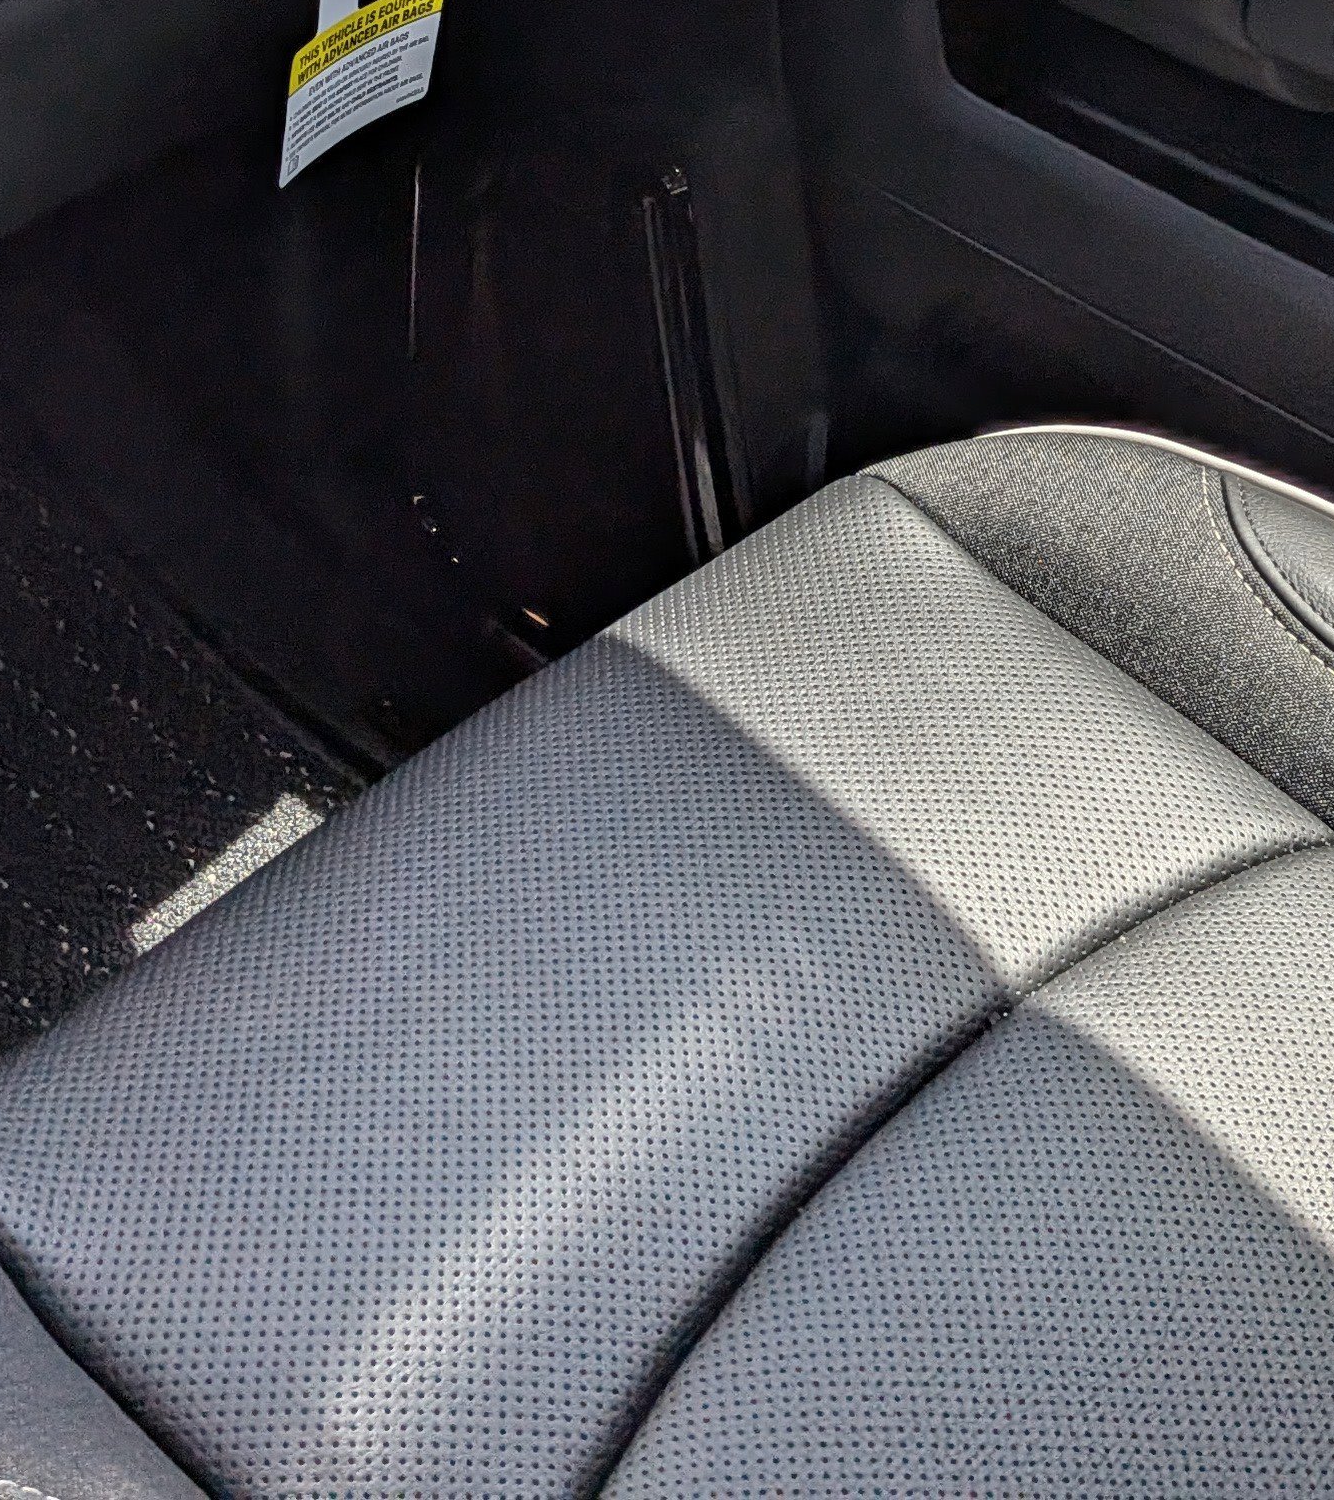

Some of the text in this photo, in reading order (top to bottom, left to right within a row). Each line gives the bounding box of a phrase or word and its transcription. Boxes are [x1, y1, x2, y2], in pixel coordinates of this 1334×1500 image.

[297, 0, 434, 85] WITH ADVANCED AIR BAGS
[300, 45, 320, 69] THIS
[322, 16, 364, 51] VEHICLE
[365, 10, 376, 25] IS
[342, 46, 377, 73] ADVANCED
[377, 40, 389, 52] AIR
[390, 31, 410, 46] BAGS
